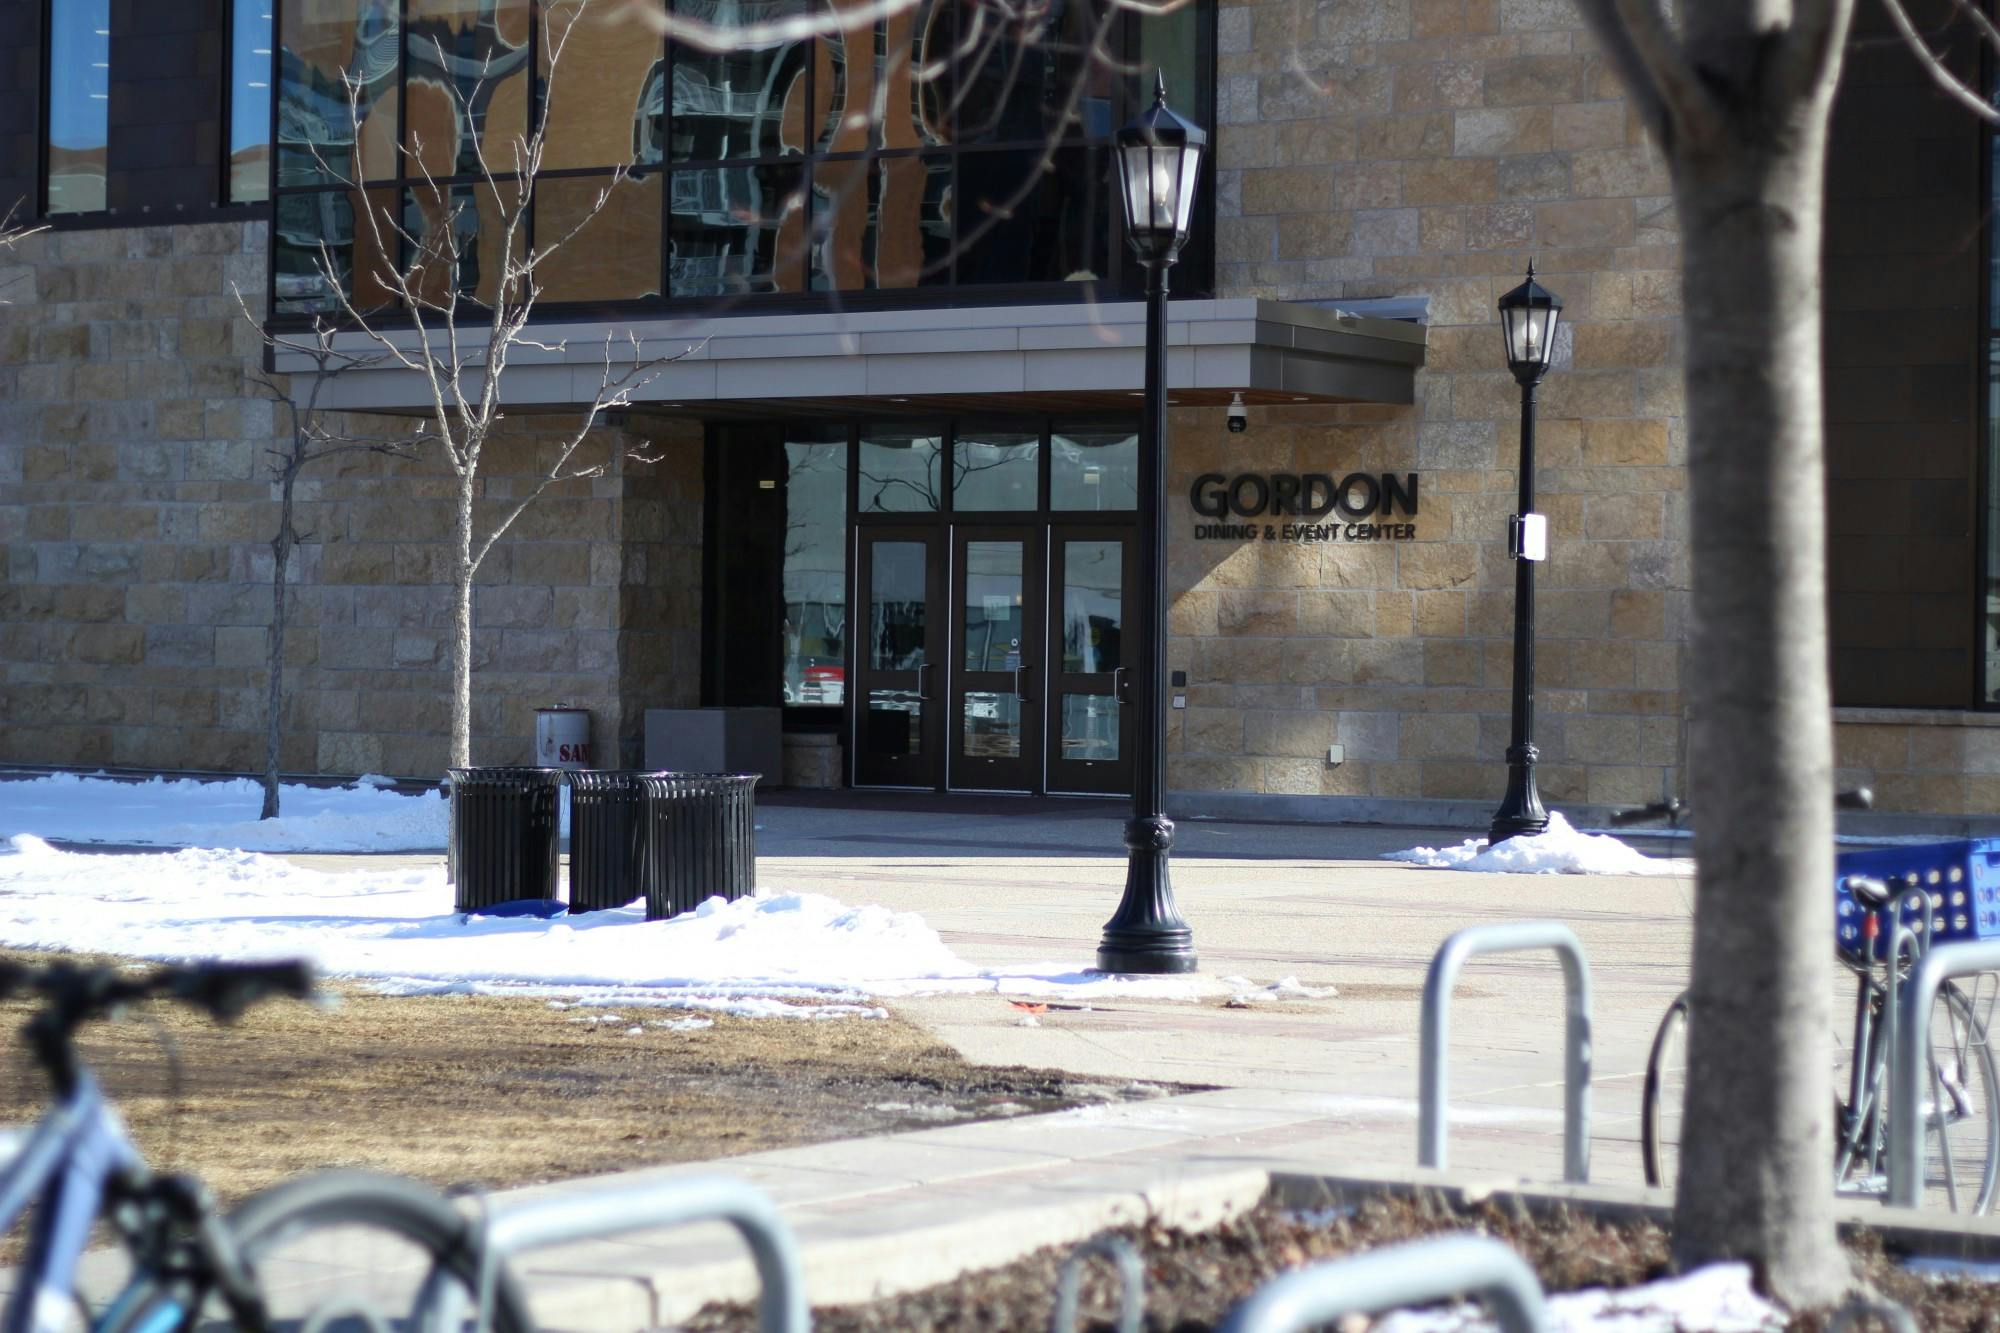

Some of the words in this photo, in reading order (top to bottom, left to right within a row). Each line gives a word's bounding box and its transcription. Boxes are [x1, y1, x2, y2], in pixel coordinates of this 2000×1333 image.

[1190, 473, 1418, 517] GORDON
[1194, 524, 1257, 540] DINING
[1264, 524, 1276, 540] &
[1281, 523, 1341, 540] EVENT
[1344, 523, 1416, 539] CENTER
